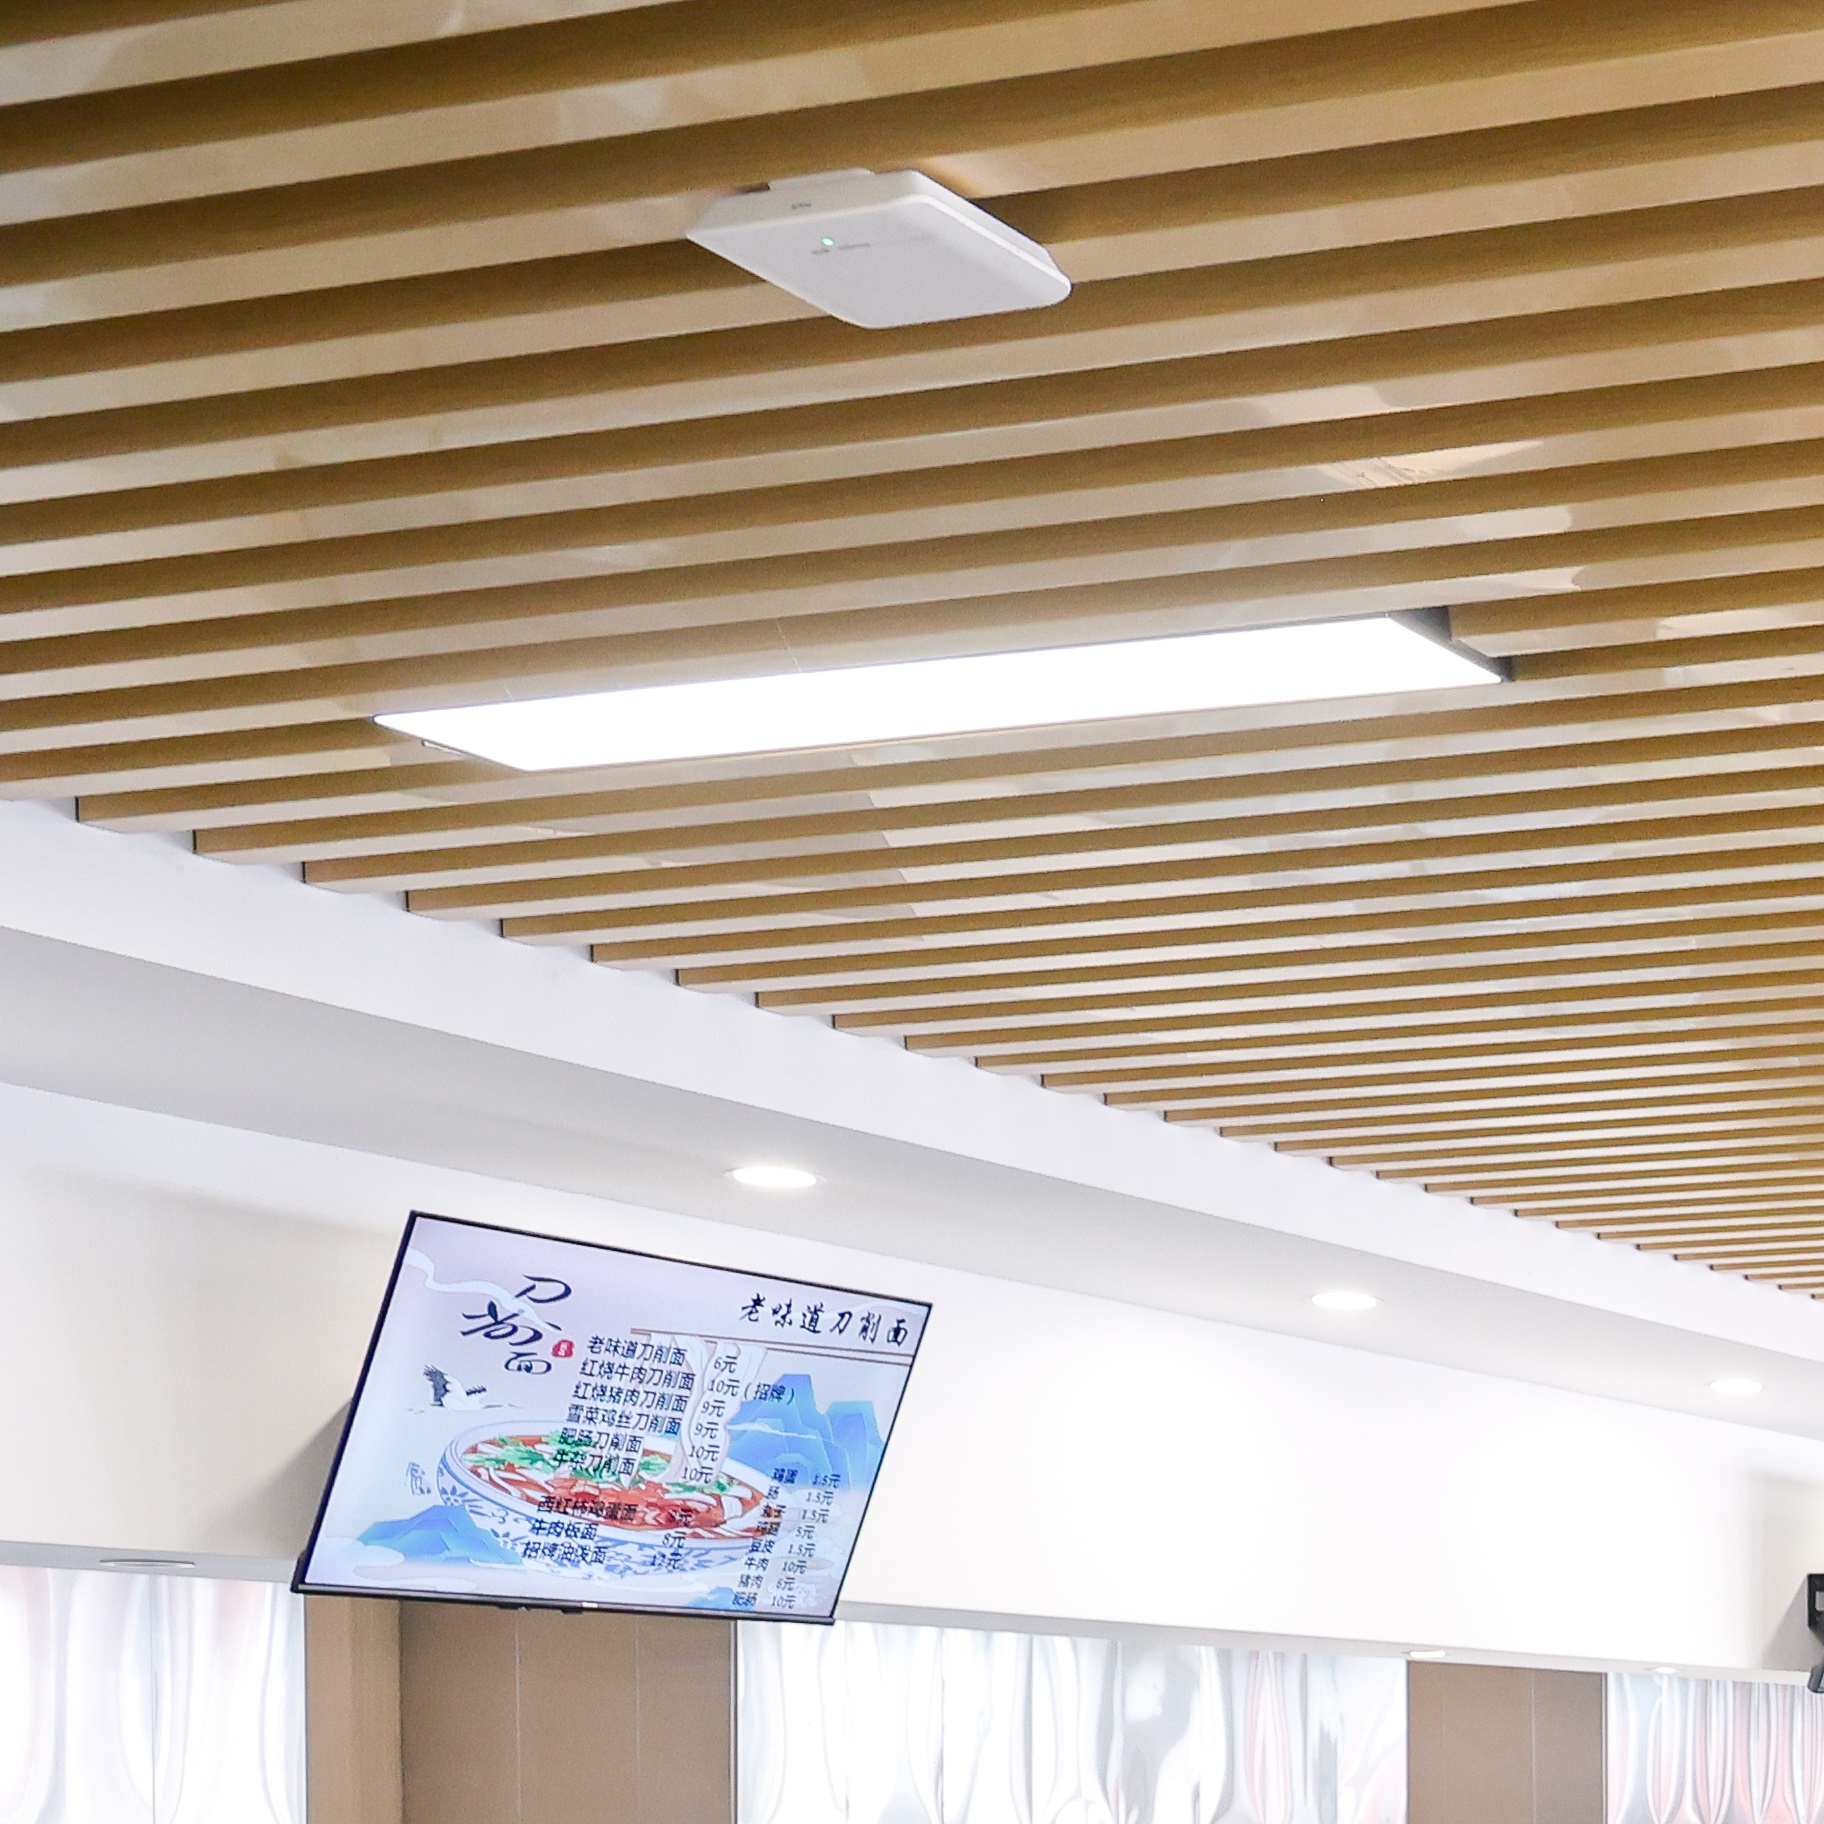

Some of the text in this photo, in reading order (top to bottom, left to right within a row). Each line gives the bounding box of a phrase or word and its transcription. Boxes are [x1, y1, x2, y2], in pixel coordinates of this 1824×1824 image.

[739, 1292, 908, 1347] 老味道刀削面
[587, 1334, 688, 1367] 老味道刀削面
[713, 1354, 738, 1374] 6元
[579, 1357, 696, 1391] 红烧牛肉刀削面
[572, 1380, 726, 1418] 红烧猪肉刀削面 9元
[565, 1402, 719, 1440] 雪菜鸡丝刀削面 9元
[557, 1426, 721, 1462] 肥肠刀削面 10元
[681, 1466, 713, 1484] 10元
